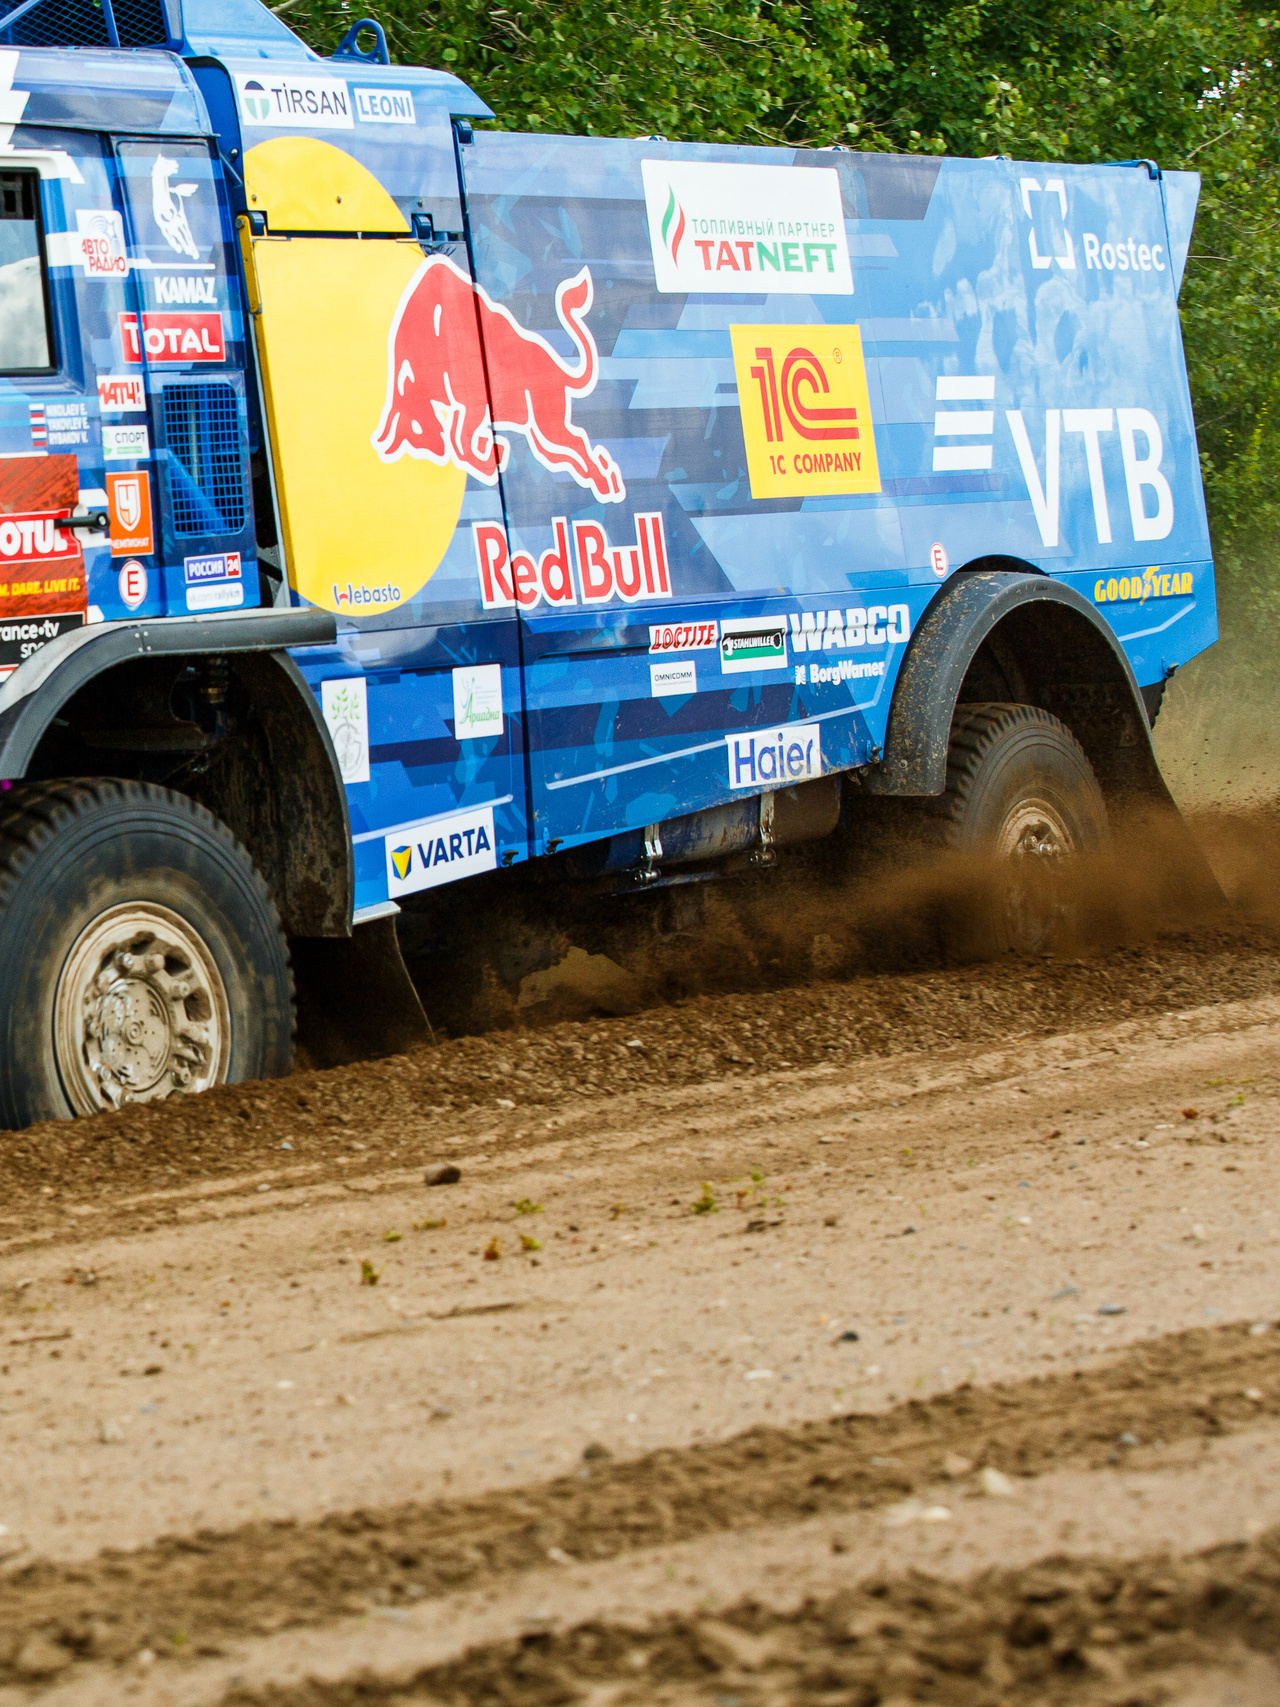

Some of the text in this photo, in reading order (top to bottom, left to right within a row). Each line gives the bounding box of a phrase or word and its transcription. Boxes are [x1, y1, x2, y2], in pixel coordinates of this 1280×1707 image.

[358, 94, 412, 118] LEONI
[691, 218, 835, 238] ТОПЛИВНЫЙ ПАРТНЕР
[89, 256, 126, 272] РАДИО
[694, 240, 837, 273] TATNEFT
[1082, 233, 1166, 271] Rostec
[154, 276, 218, 303] KAMAZ
[123, 321, 220, 354] TOTAL
[115, 432, 145, 443] СПОРТ
[770, 452, 861, 475] 1C COMPANY
[1005, 408, 1174, 547] VTB
[188, 559, 239, 577] РОССИЯ 24
[476, 517, 670, 605] Red Bull
[11, 581, 42, 596] DARE.
[44, 579, 67, 594] LIVE
[127, 571, 139, 596] E
[333, 583, 401, 606] Webasto
[1093, 568, 1195, 603] GOODYEAR
[651, 624, 716, 651] LOCTITE
[790, 604, 911, 653] WABCO
[733, 635, 774, 650] STAHLWILLE
[654, 671, 693, 681] OMNICOMM
[810, 660, 885, 686] BorgWarner
[734, 732, 813, 784] Haier
[417, 825, 491, 869] VARTA
